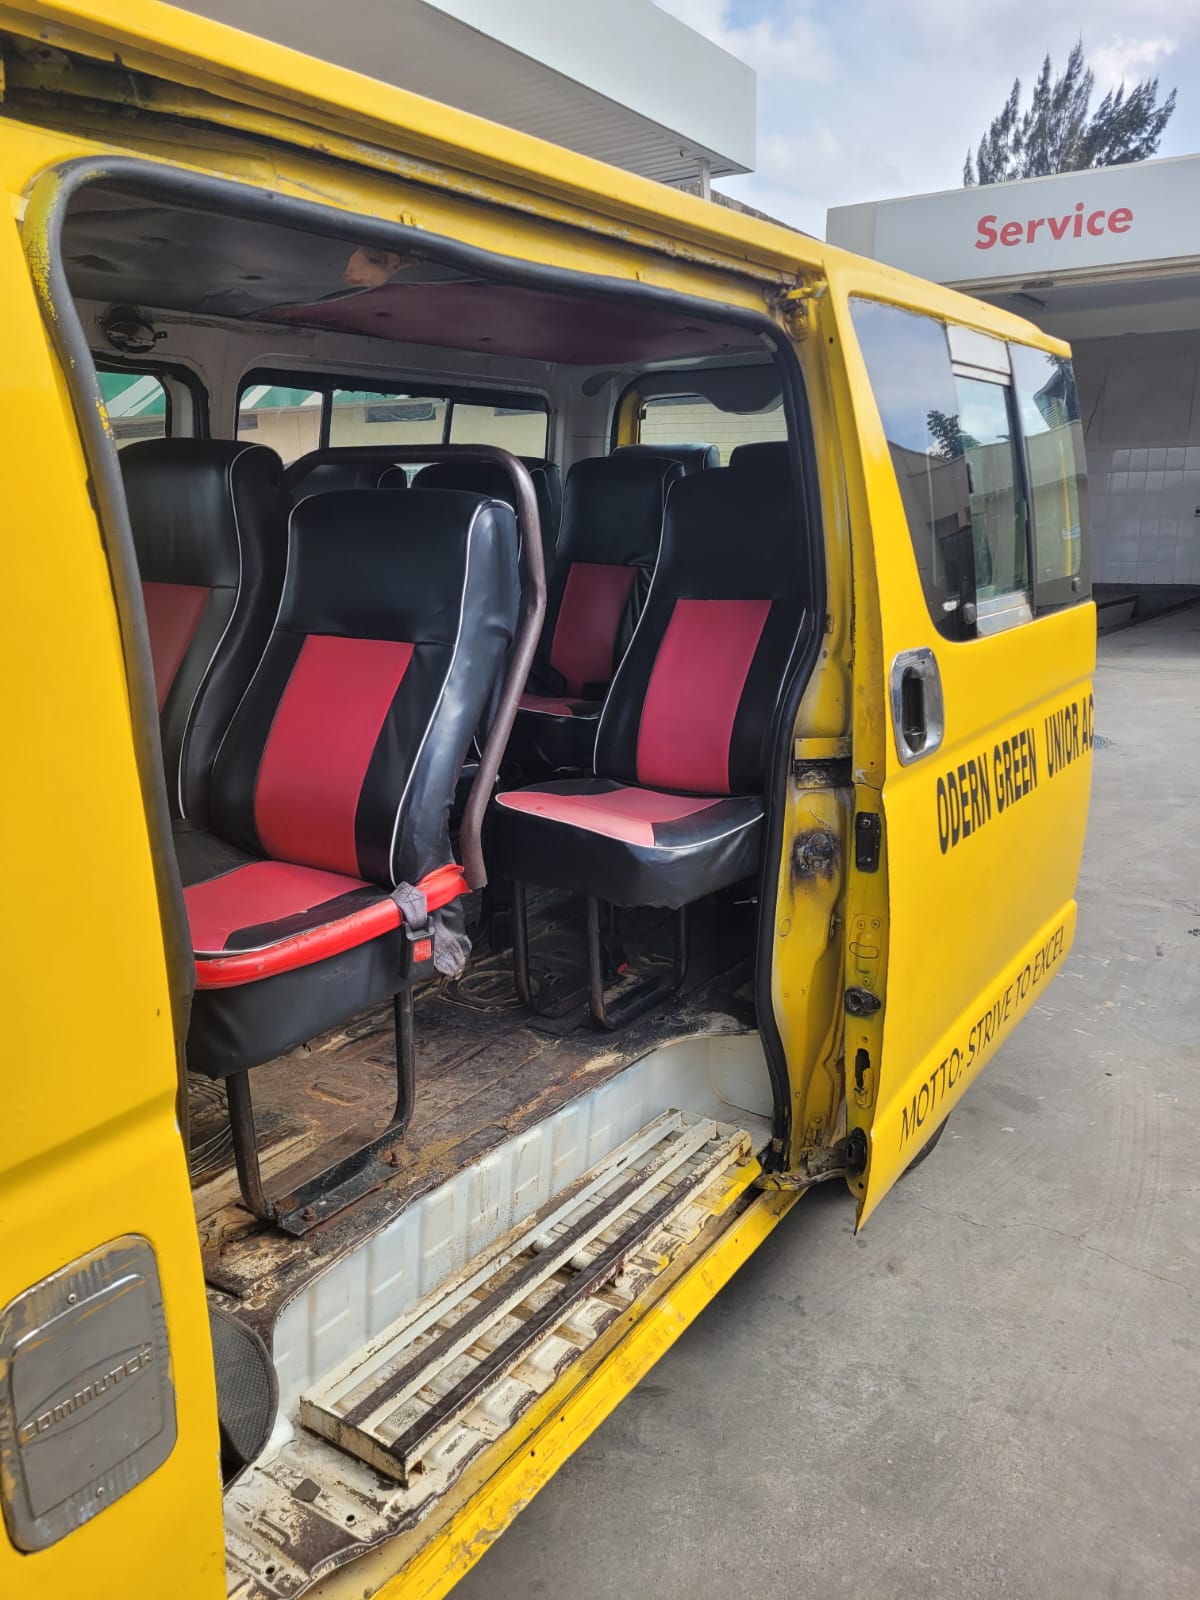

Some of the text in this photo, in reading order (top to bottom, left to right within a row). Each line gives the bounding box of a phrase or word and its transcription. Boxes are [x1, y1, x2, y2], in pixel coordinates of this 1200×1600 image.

[974, 202, 1133, 250] Service
[936, 751, 992, 856] ODERN
[993, 727, 1038, 814] GREEN
[1044, 702, 1080, 779] UNIOR
[966, 983, 1014, 1068] STRIVE
[1015, 964, 1032, 1009] TO
[1032, 925, 1065, 986] EXCEL
[20, 1346, 154, 1442] COMMUTER
